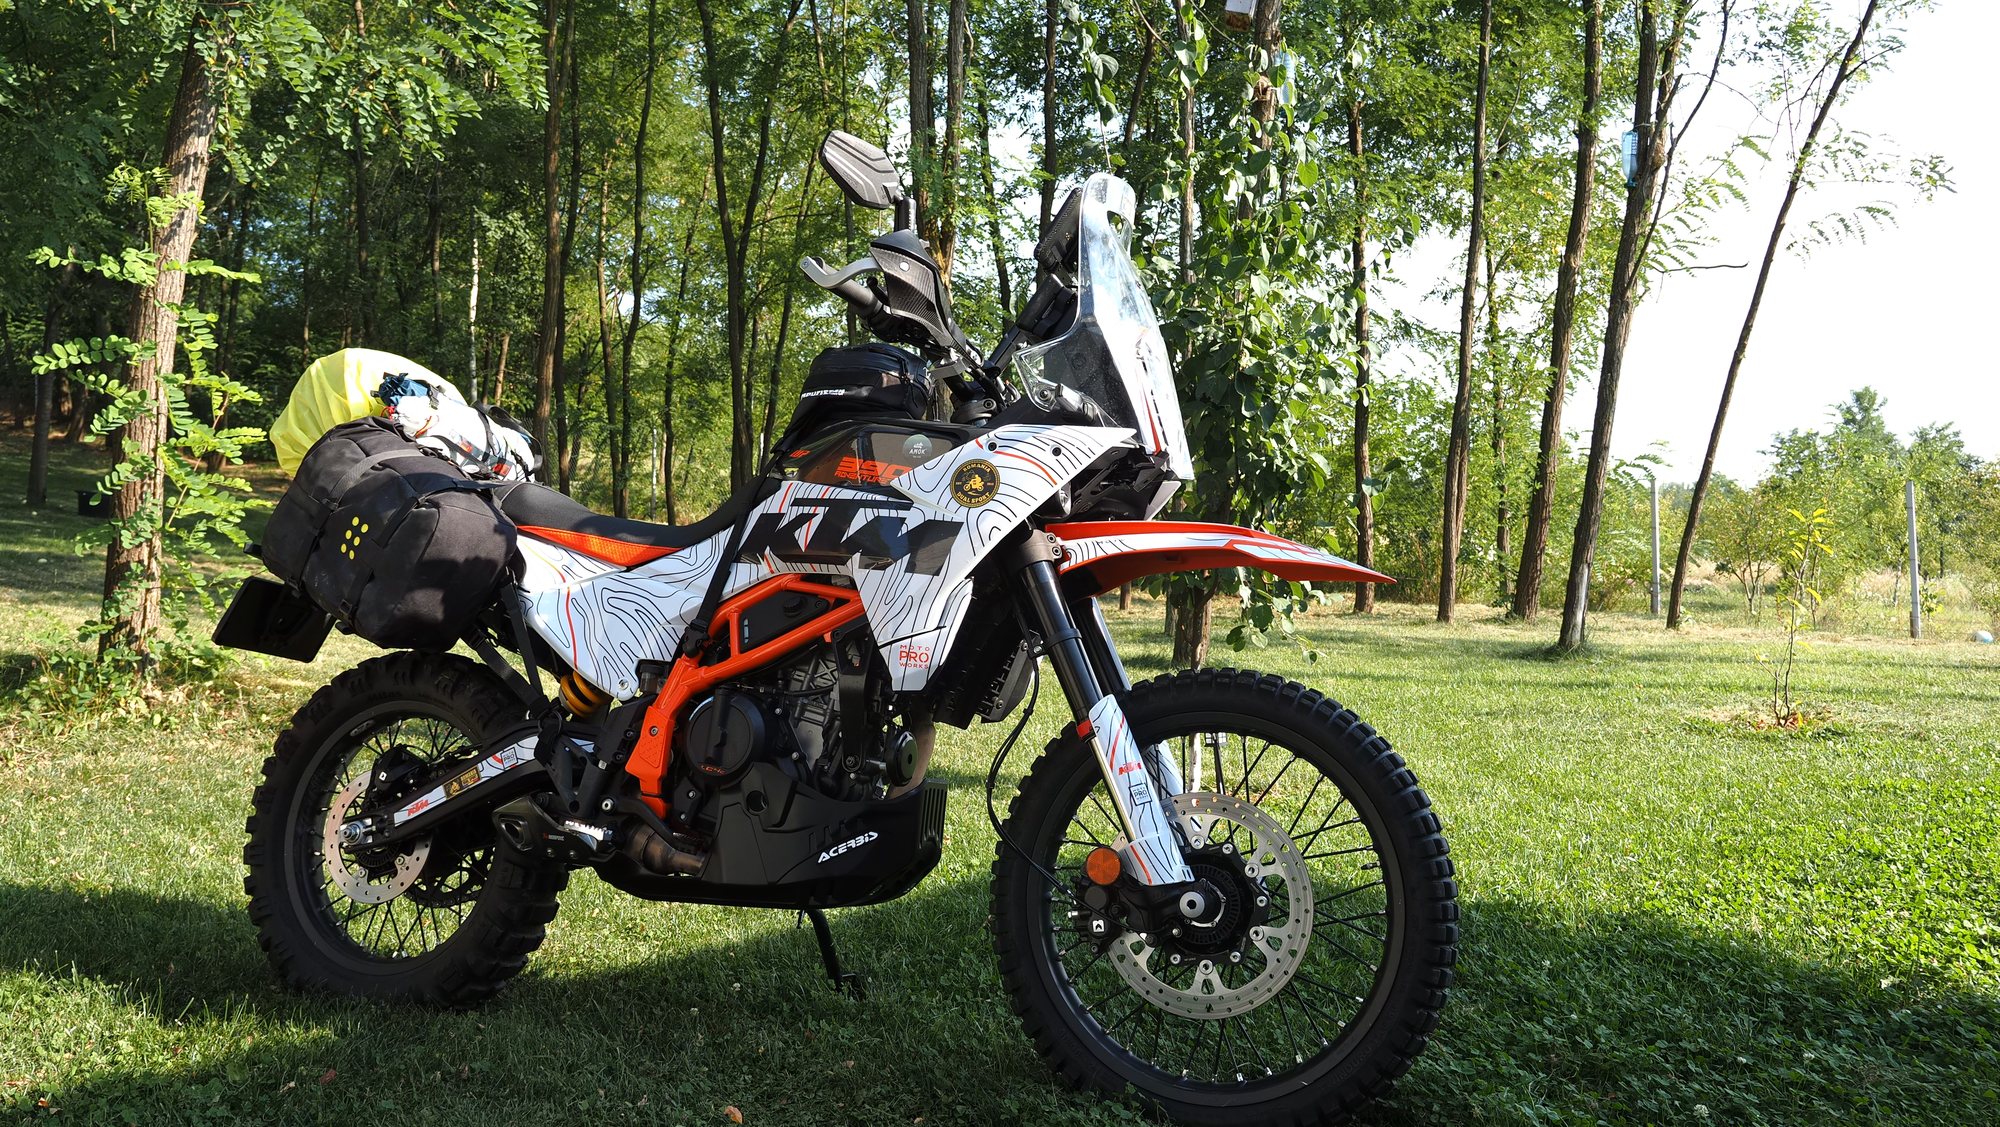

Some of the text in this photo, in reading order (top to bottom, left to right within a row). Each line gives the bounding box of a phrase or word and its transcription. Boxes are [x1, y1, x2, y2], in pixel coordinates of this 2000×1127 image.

[963, 463, 990, 472] ROMANIA
[957, 492, 990, 502] DUAL SPORT
[738, 498, 964, 576] KTM
[899, 651, 929, 663] PRO
[899, 662, 929, 670] WORKS
[407, 799, 429, 816] KTM
